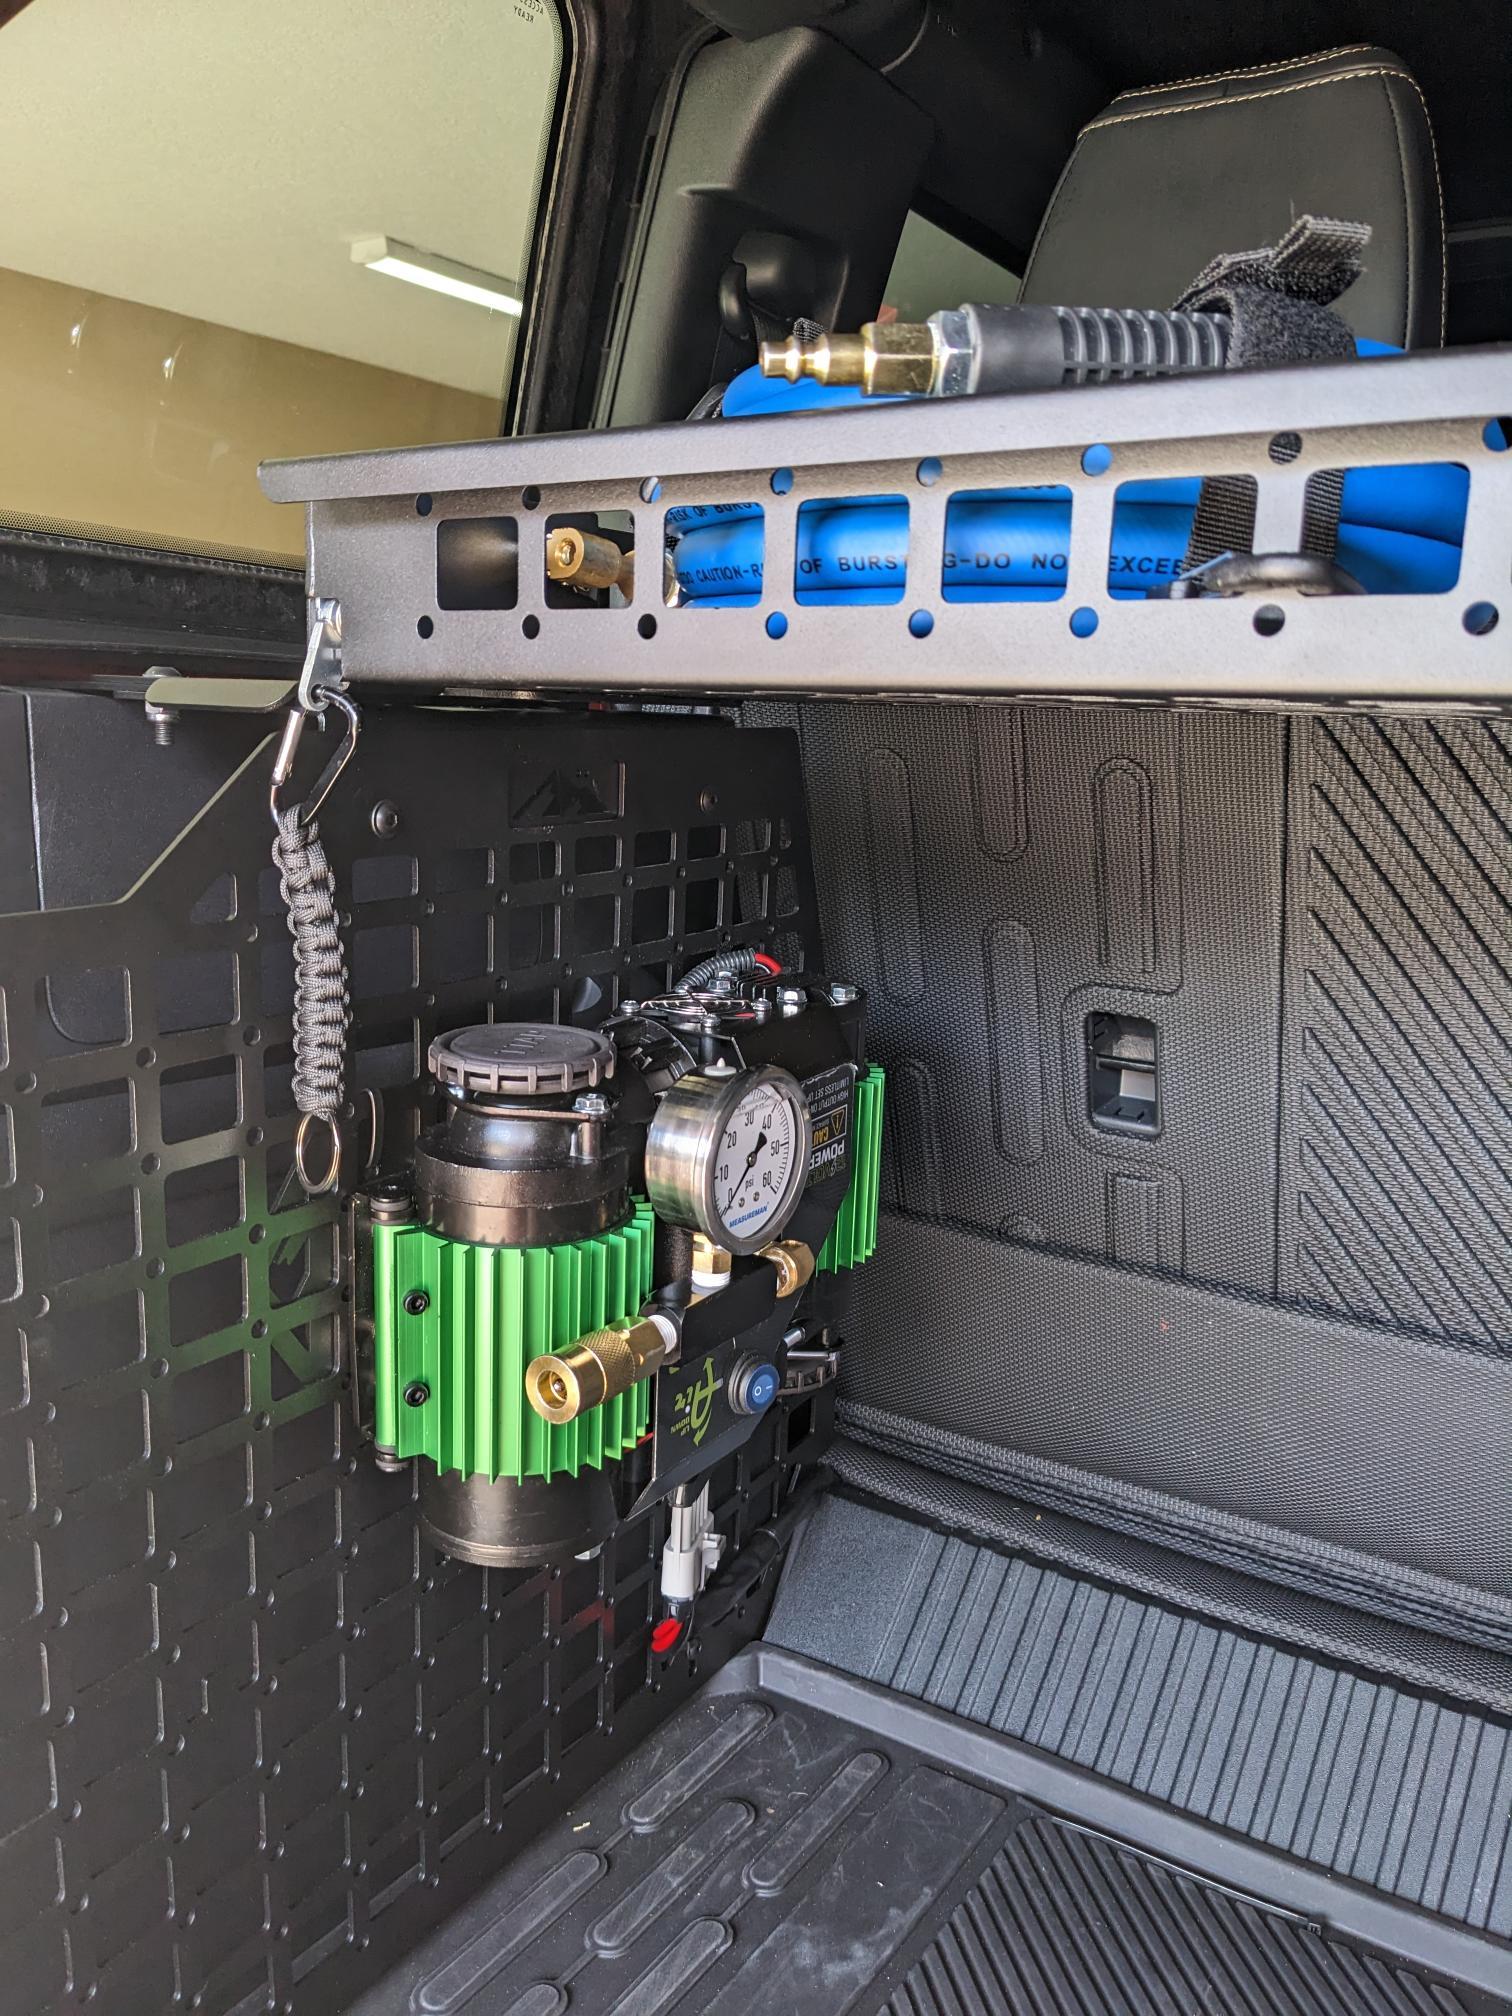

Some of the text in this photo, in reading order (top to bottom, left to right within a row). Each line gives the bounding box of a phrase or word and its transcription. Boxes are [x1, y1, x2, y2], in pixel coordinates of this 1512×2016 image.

[799, 559, 823, 574] OF
[744, 1110, 755, 1127] 30
[762, 1113, 772, 1131] 40
[727, 1130, 738, 1149] 20
[770, 1139, 780, 1157] 50
[720, 1164, 729, 1182] 10
[762, 1170, 772, 1188] 60
[745, 1174, 754, 1192] psi
[729, 1205, 768, 1228] MEASUREMAN
